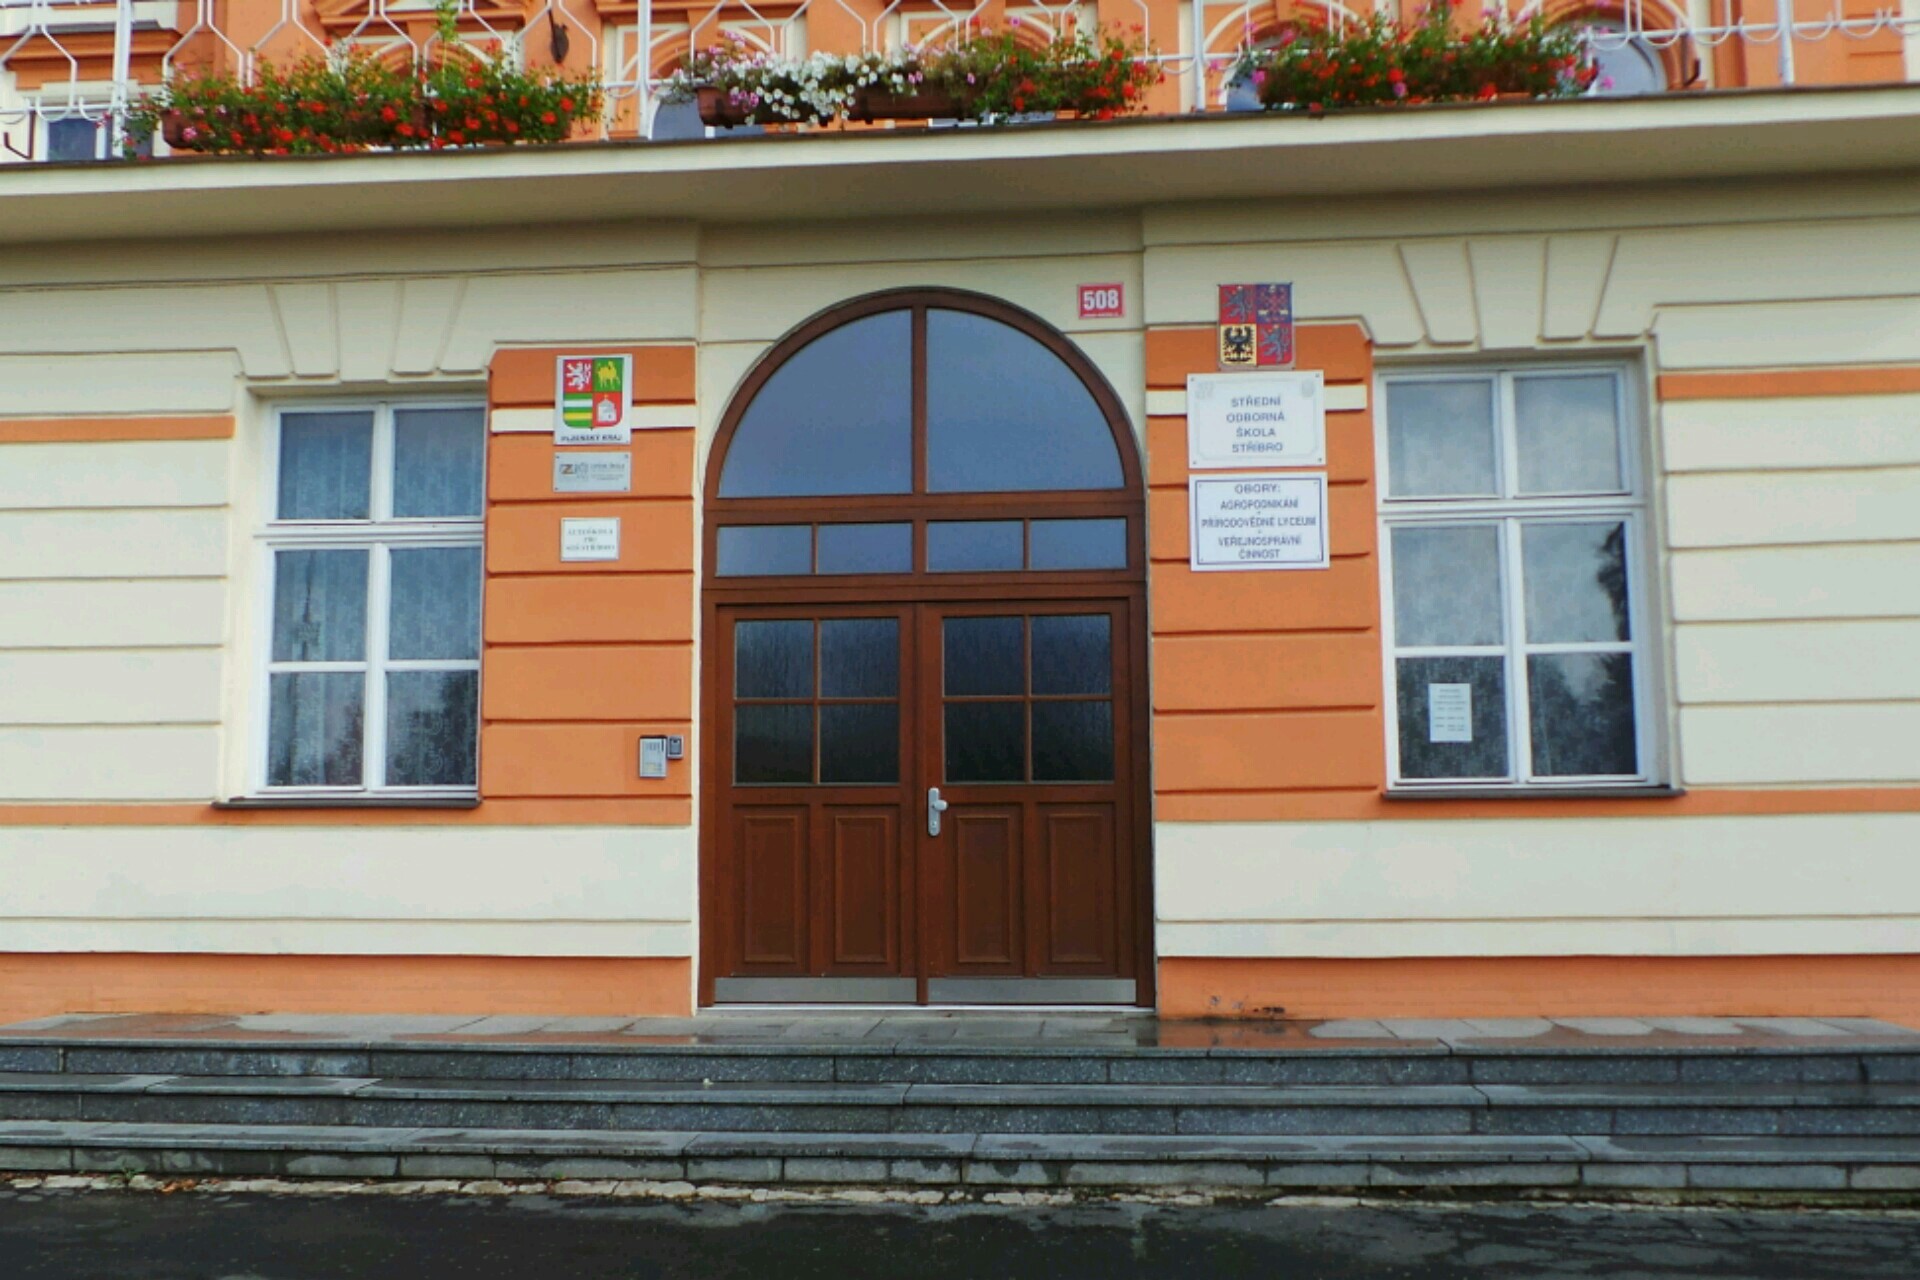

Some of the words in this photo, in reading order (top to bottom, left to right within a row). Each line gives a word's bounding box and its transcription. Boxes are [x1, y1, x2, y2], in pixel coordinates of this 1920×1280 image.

[1084, 290, 1119, 310] 508
[1231, 395, 1281, 407] STŘEDNÍ
[1226, 411, 1285, 423] ODBORNÁ
[1236, 427, 1276, 437] ŠKOLA
[1232, 441, 1283, 453] STŘÍBRO
[1234, 483, 1281, 494] OBORY:
[1277, 516, 1316, 526] LYCEUM
